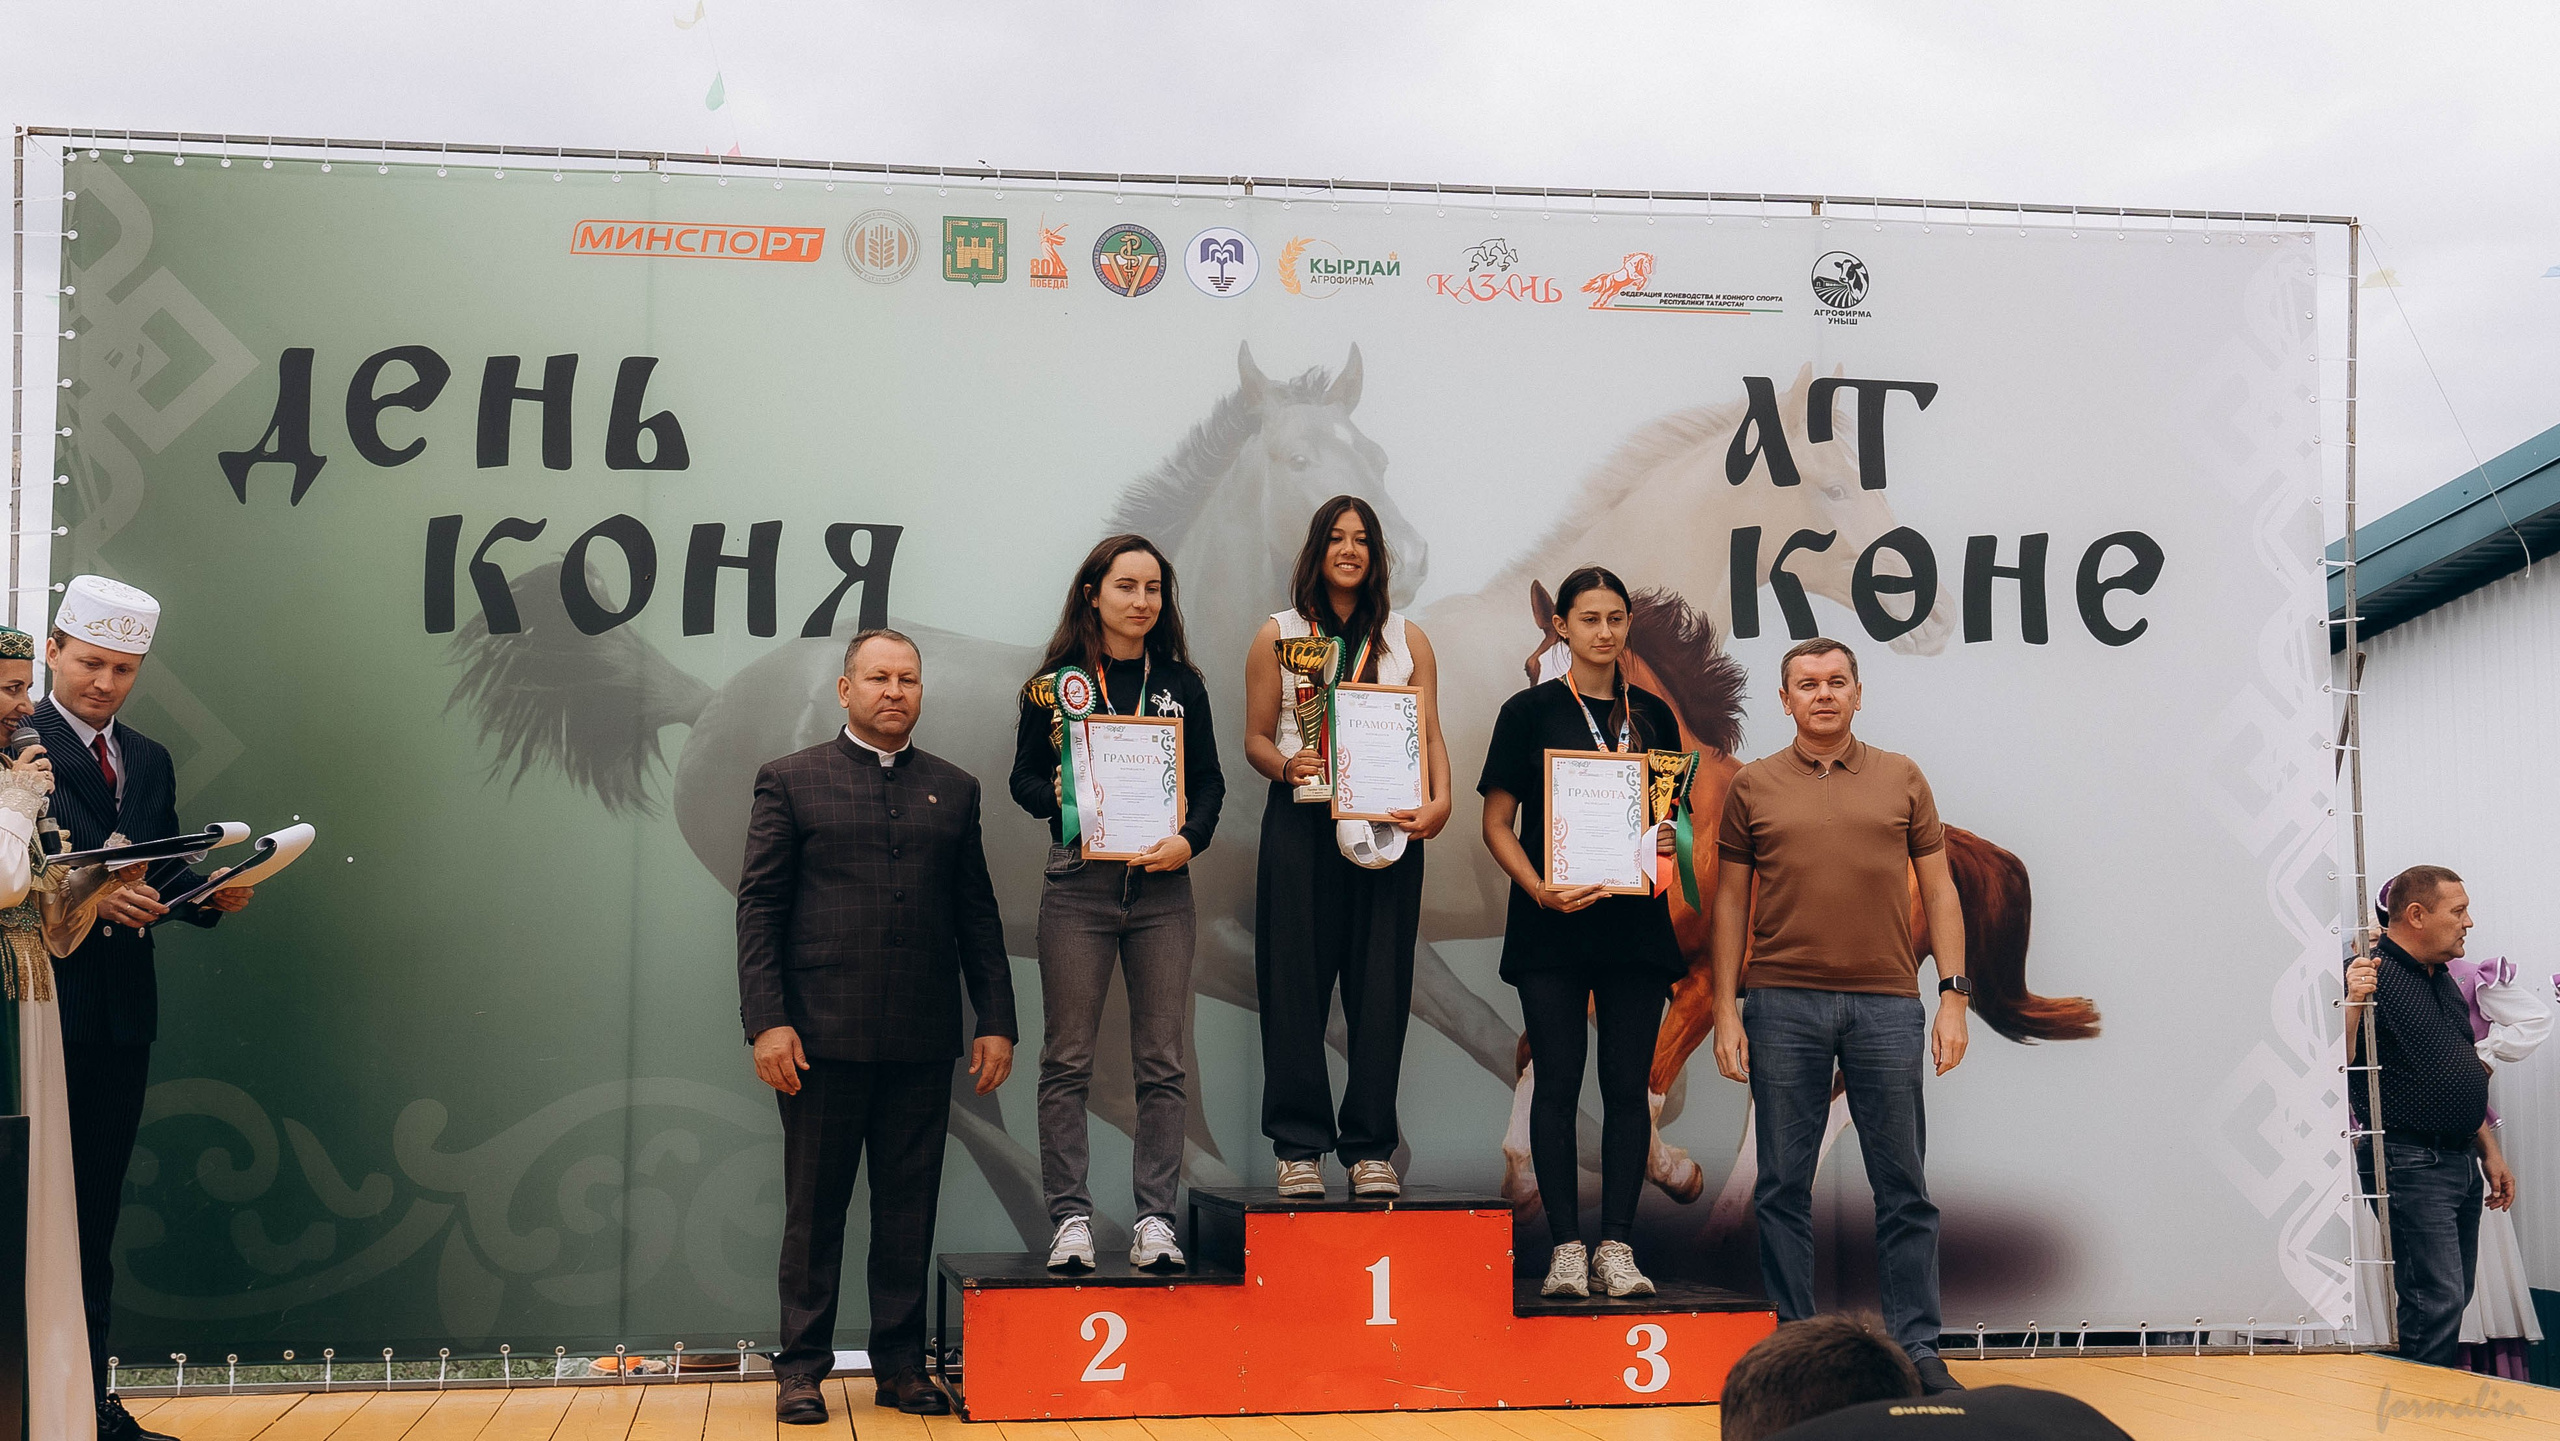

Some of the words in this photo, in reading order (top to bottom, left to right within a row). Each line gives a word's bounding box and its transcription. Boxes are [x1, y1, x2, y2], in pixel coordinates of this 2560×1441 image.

[579, 225, 821, 257] МИНСПОРТ
[1029, 258, 1051, 275] 80
[1309, 251, 1401, 277] КЫРЛАЙ
[1029, 279, 1069, 290] ПОБЕДА!
[1310, 275, 1375, 286] АГРОФИРМА
[1426, 273, 1564, 304] КАЗАНЬ
[1620, 290, 1662, 298] ФЕДЕРАЦИЯ
[1813, 309, 1872, 318] АГРОФИРМА
[1827, 317, 1858, 325] УНЫШ
[217, 345, 690, 507] ДЕНЬ
[1725, 376, 1939, 490] АТ
[424, 513, 904, 637] КОНЯ
[1349, 718, 1404, 731] ГРАМОТА
[1103, 753, 1161, 765] ГРАМОТА
[1568, 787, 1626, 800] ГРАМОТА
[1365, 1256, 1398, 1326] 1
[1080, 1311, 1127, 1382] 2
[1623, 1323, 1671, 1393] 3
